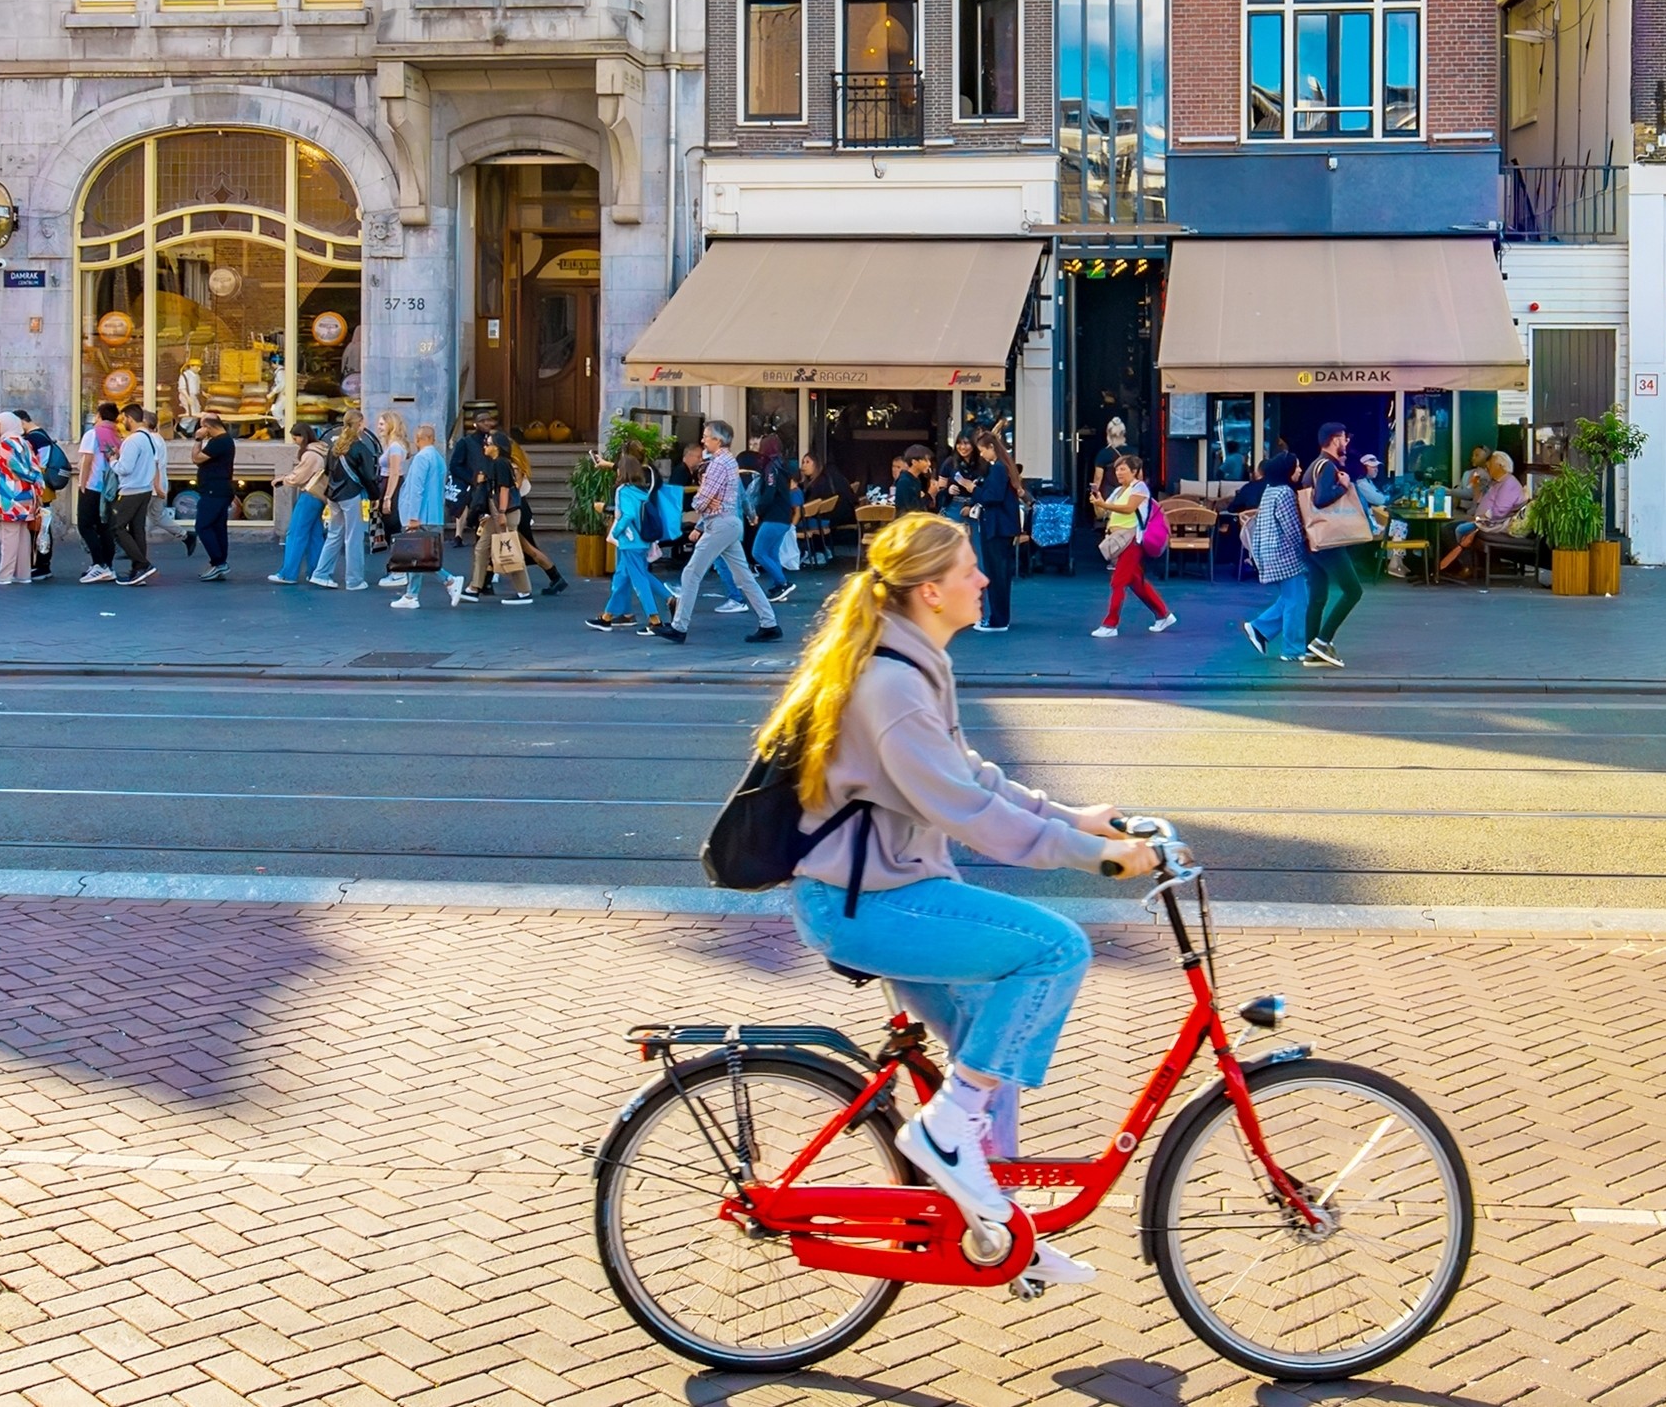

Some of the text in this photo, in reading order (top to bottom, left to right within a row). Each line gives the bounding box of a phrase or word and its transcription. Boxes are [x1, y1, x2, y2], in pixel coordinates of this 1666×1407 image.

[10, 272, 39, 280] DAMRAK
[763, 371, 868, 381] BRAVI RAGAZZI
[1315, 371, 1391, 382] DAMRAK
[1639, 380, 1654, 391] 34
